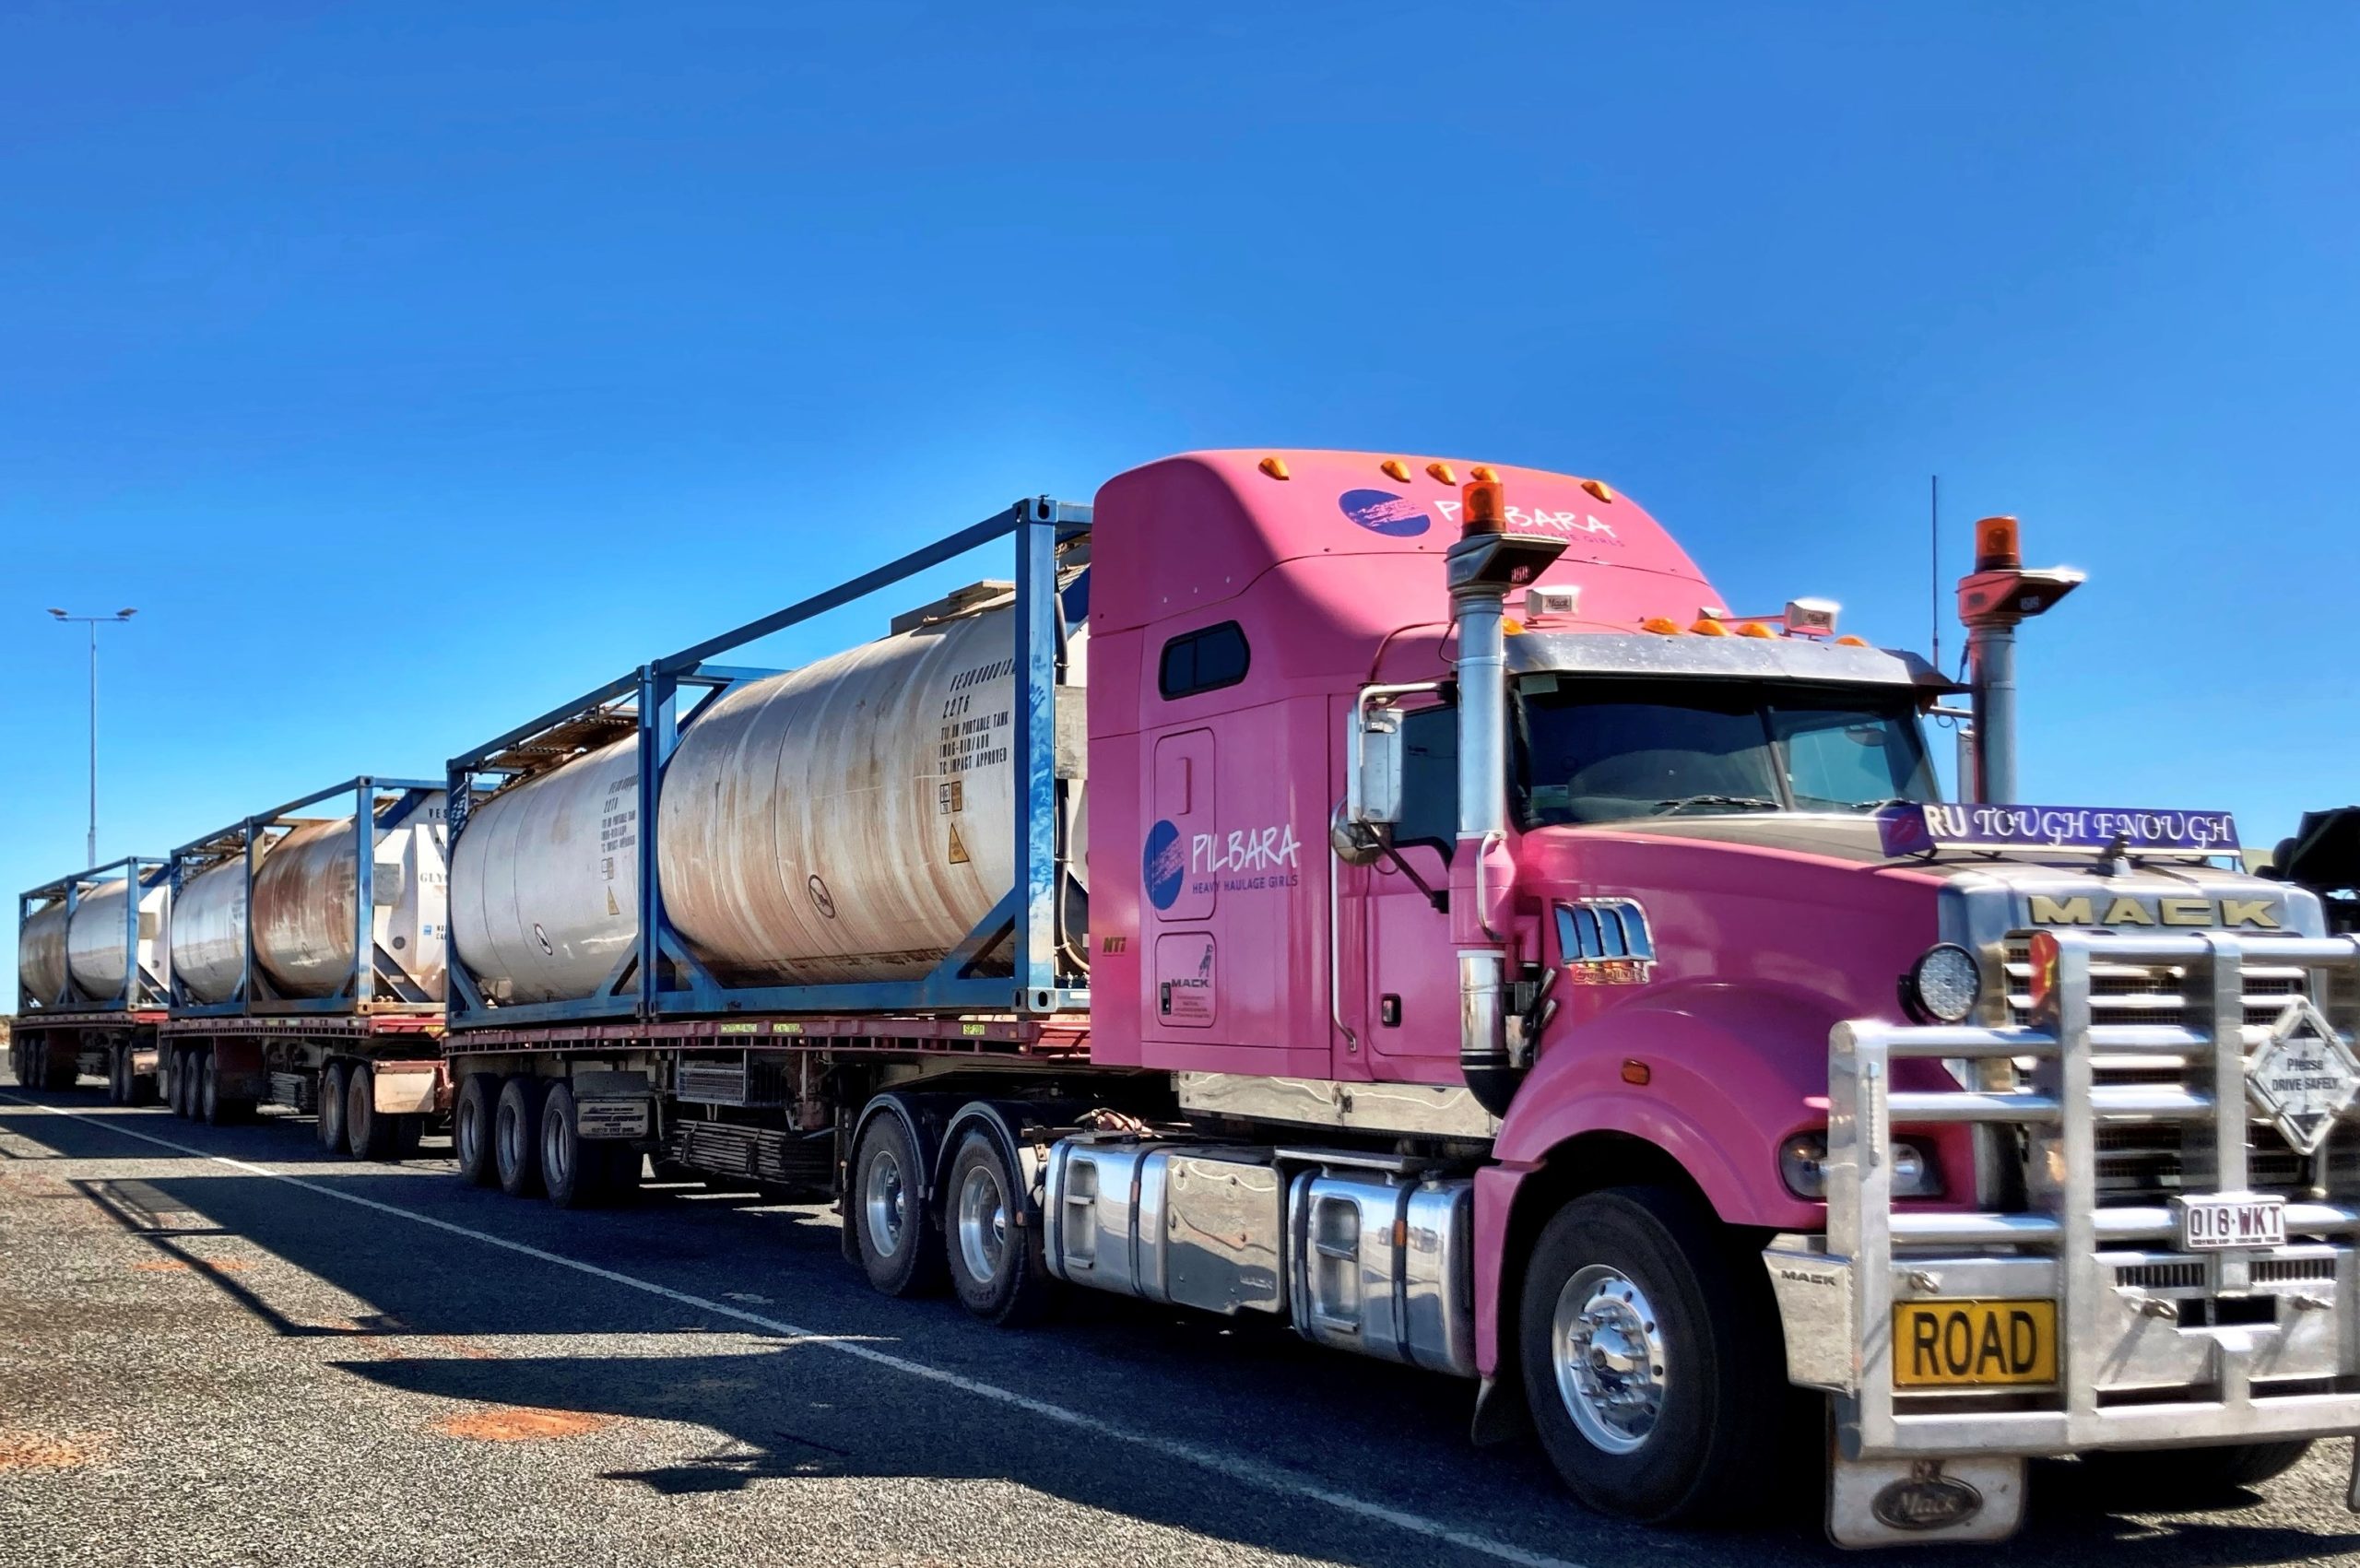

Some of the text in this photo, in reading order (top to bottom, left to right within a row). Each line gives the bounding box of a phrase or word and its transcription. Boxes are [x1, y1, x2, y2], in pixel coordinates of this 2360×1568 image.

[1434, 501, 1618, 538] PBARA
[942, 694, 970, 719] 22T6
[962, 715, 990, 736] PORTABLE
[993, 711, 1009, 728] TANK
[950, 755, 972, 772] IMPACT
[976, 747, 1008, 768] APPROVED
[1922, 805, 2234, 850] RU TOUGH ENOUGH
[1192, 823, 1301, 874] PILBARA
[1192, 874, 1298, 894] HEAVY HAULAGE GIRLS
[2028, 895, 2280, 928] MACK
[1171, 978, 1209, 988] MACK
[2287, 1058, 2323, 1071] Please
[2272, 1079, 2302, 1091] DRIVE
[1781, 1269, 1836, 1286] MACK
[1913, 1310, 2037, 1376] ROAD
